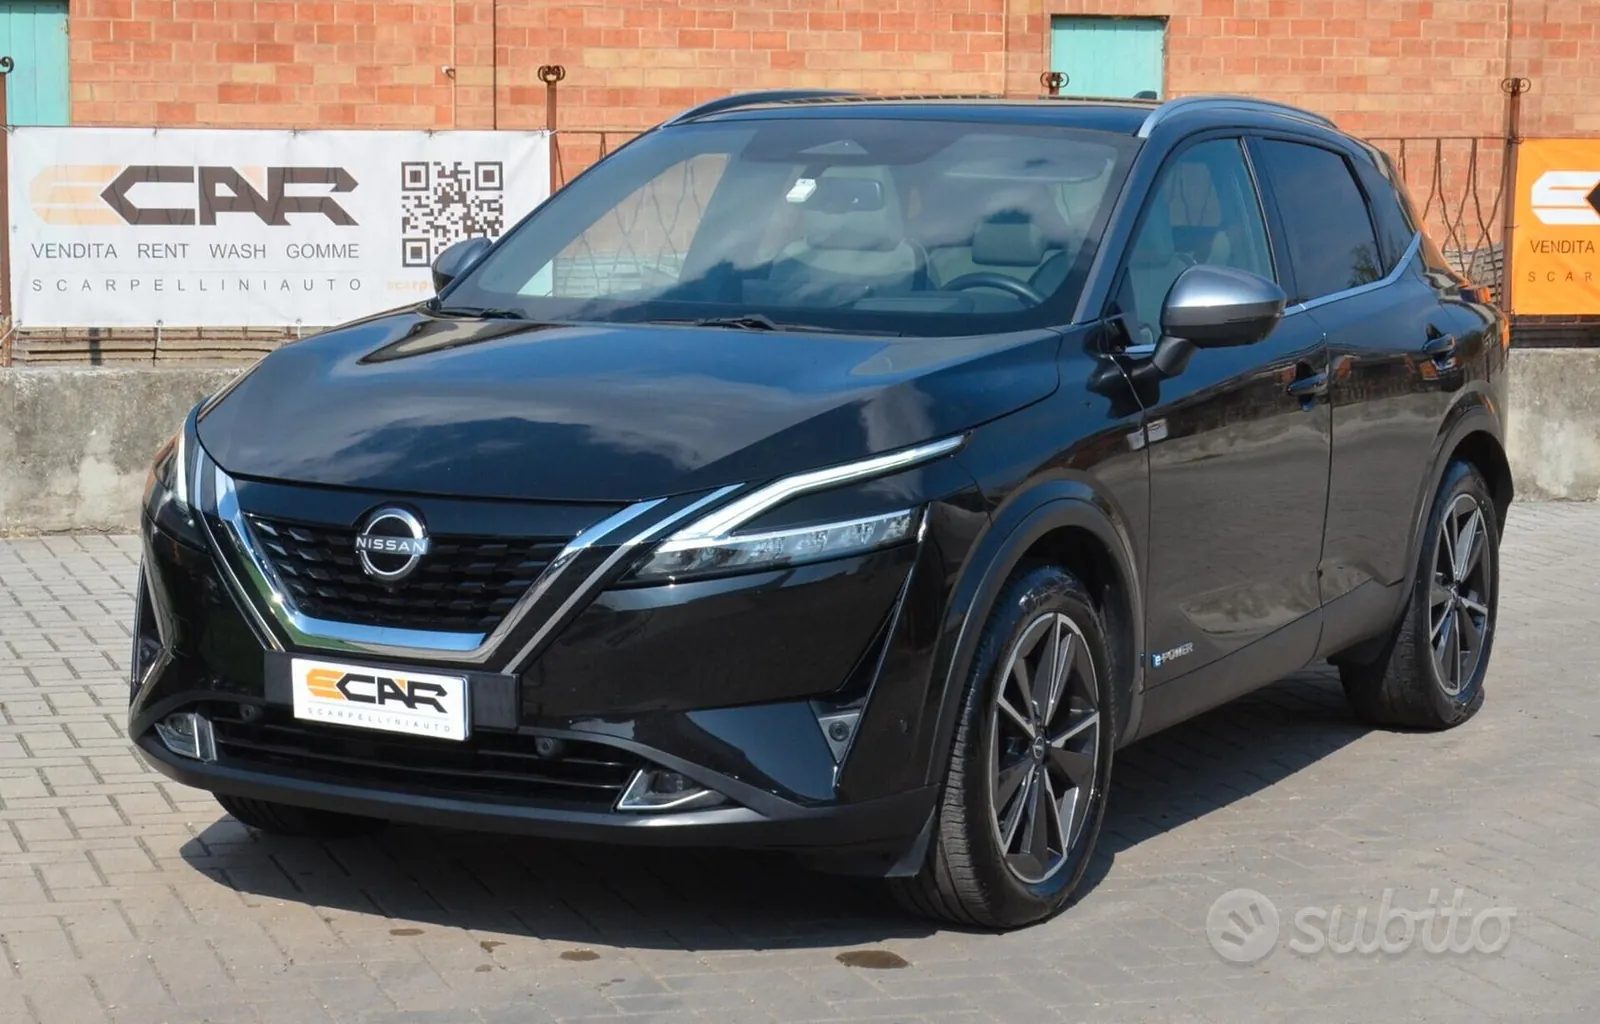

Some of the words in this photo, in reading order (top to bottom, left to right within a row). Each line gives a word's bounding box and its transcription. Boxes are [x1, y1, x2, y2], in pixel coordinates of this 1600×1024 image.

[31, 243, 118, 259] VENDITA
[137, 243, 190, 259] RENT
[209, 243, 267, 259] WASH
[286, 243, 360, 259] GOMME
[1529, 239, 1595, 254] VENDITA
[32, 278, 361, 292] SCARPELLINIAUTO
[386, 280, 434, 293] scarp
[356, 536, 428, 553] NISSAN
[307, 706, 451, 733] SCARPELLINIAUTO
